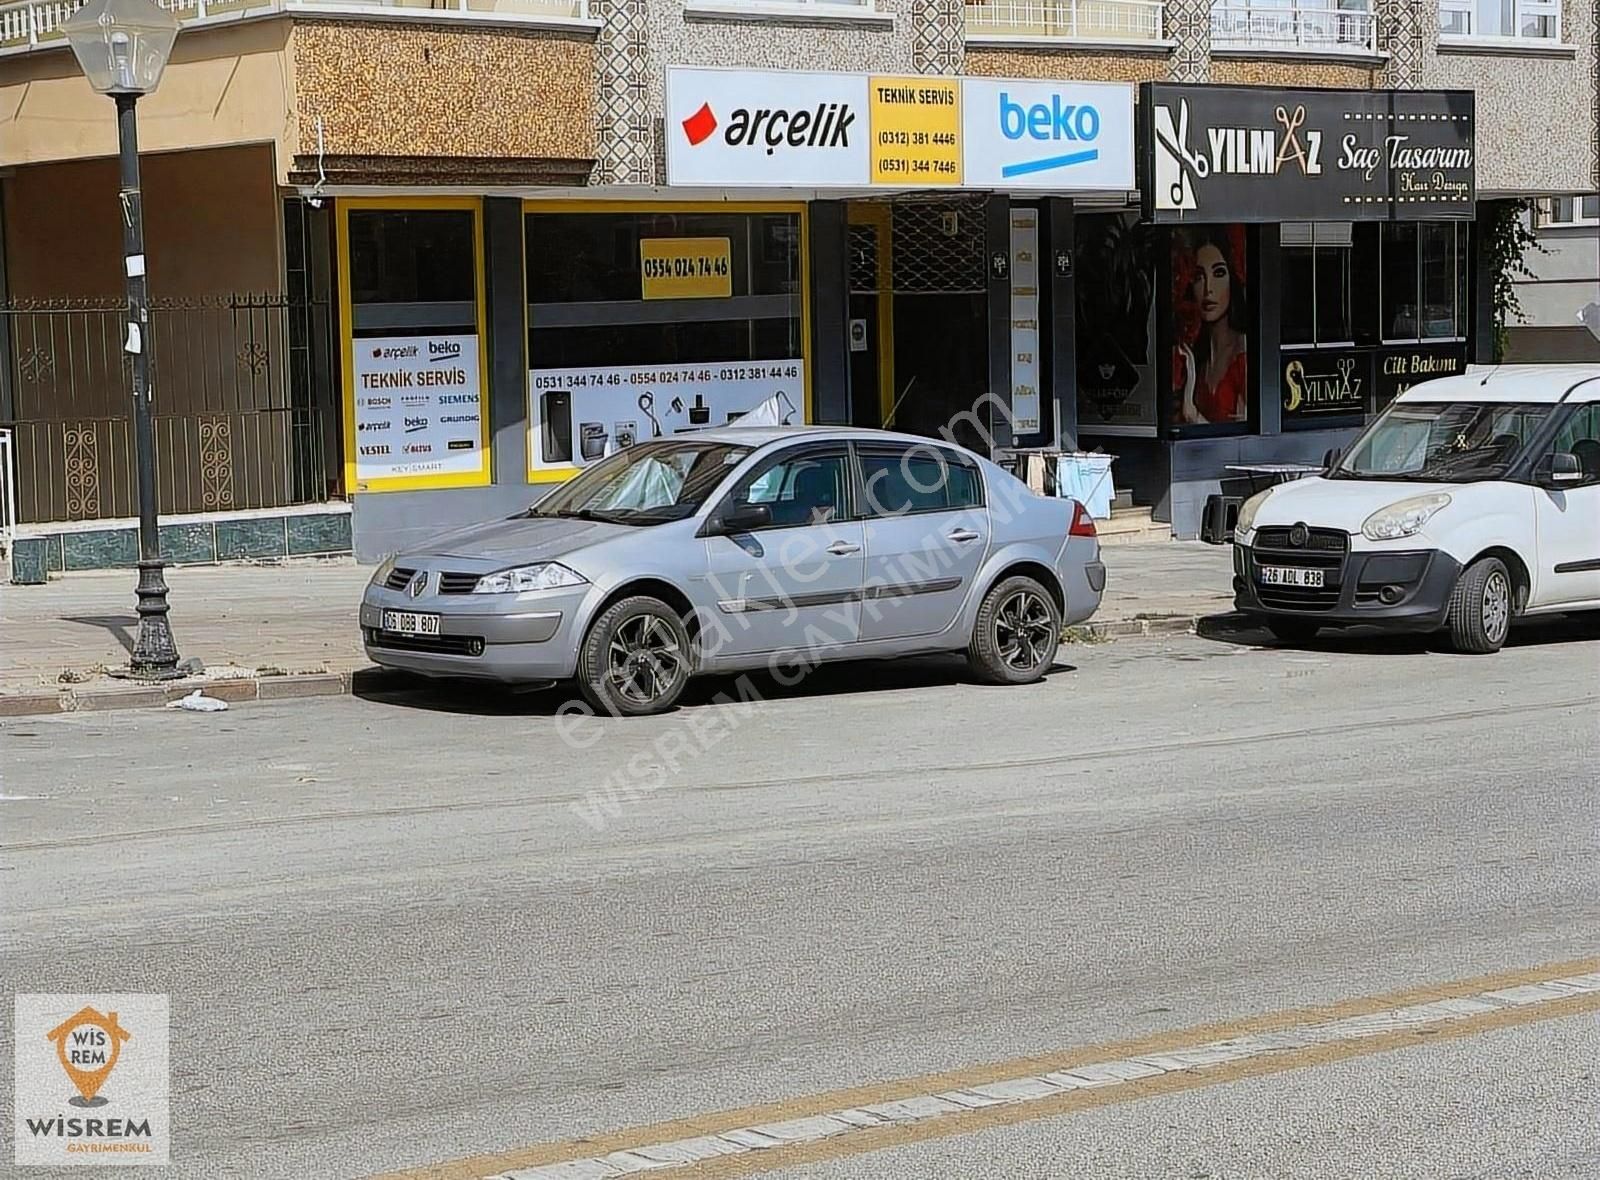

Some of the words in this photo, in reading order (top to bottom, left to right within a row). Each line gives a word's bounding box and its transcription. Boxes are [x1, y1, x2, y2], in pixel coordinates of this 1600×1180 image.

[877, 85, 916, 104] TEKNİK
[918, 87, 954, 106] SERVİS
[1000, 93, 1100, 142] beko
[725, 103, 856, 156] arçelik
[878, 131, 909, 146] (0312)
[912, 133, 929, 145] 381
[932, 133, 956, 145] 4446
[1207, 105, 1323, 175] YILMAZ
[1338, 133, 1382, 182] Saç
[878, 159, 909, 174] (0531)
[912, 160, 930, 172] 344
[933, 160, 956, 174] 7446
[644, 258, 672, 278] 0554
[674, 257, 695, 277] 024
[698, 256, 712, 276] 74
[714, 256, 728, 276] 46
[383, 346, 419, 360] arçelik
[428, 341, 460, 354] beko
[1383, 356, 1408, 376] Cilt
[361, 369, 413, 389] TEKNİK
[416, 366, 466, 387] SERVİS
[536, 376, 562, 389] 0531
[566, 375, 587, 387] 344
[590, 374, 604, 386] 74
[606, 373, 621, 385] 46
[630, 372, 656, 385] 0554
[660, 371, 679, 383] 024
[682, 370, 695, 382] 74
[698, 369, 712, 381] 46
[720, 369, 746, 381] 0312
[748, 368, 766, 379] 381
[769, 367, 781, 378] 44
[784, 366, 798, 378] 46
[367, 397, 391, 406] BOSCH
[438, 394, 480, 405] SIEMENS
[404, 416, 429, 428] beko
[440, 414, 480, 424] GRUNDIG
[359, 445, 392, 456] VESTEL
[1267, 569, 1278, 583] 26
[1304, 571, 1322, 586] 838
[422, 616, 438, 633] 807
